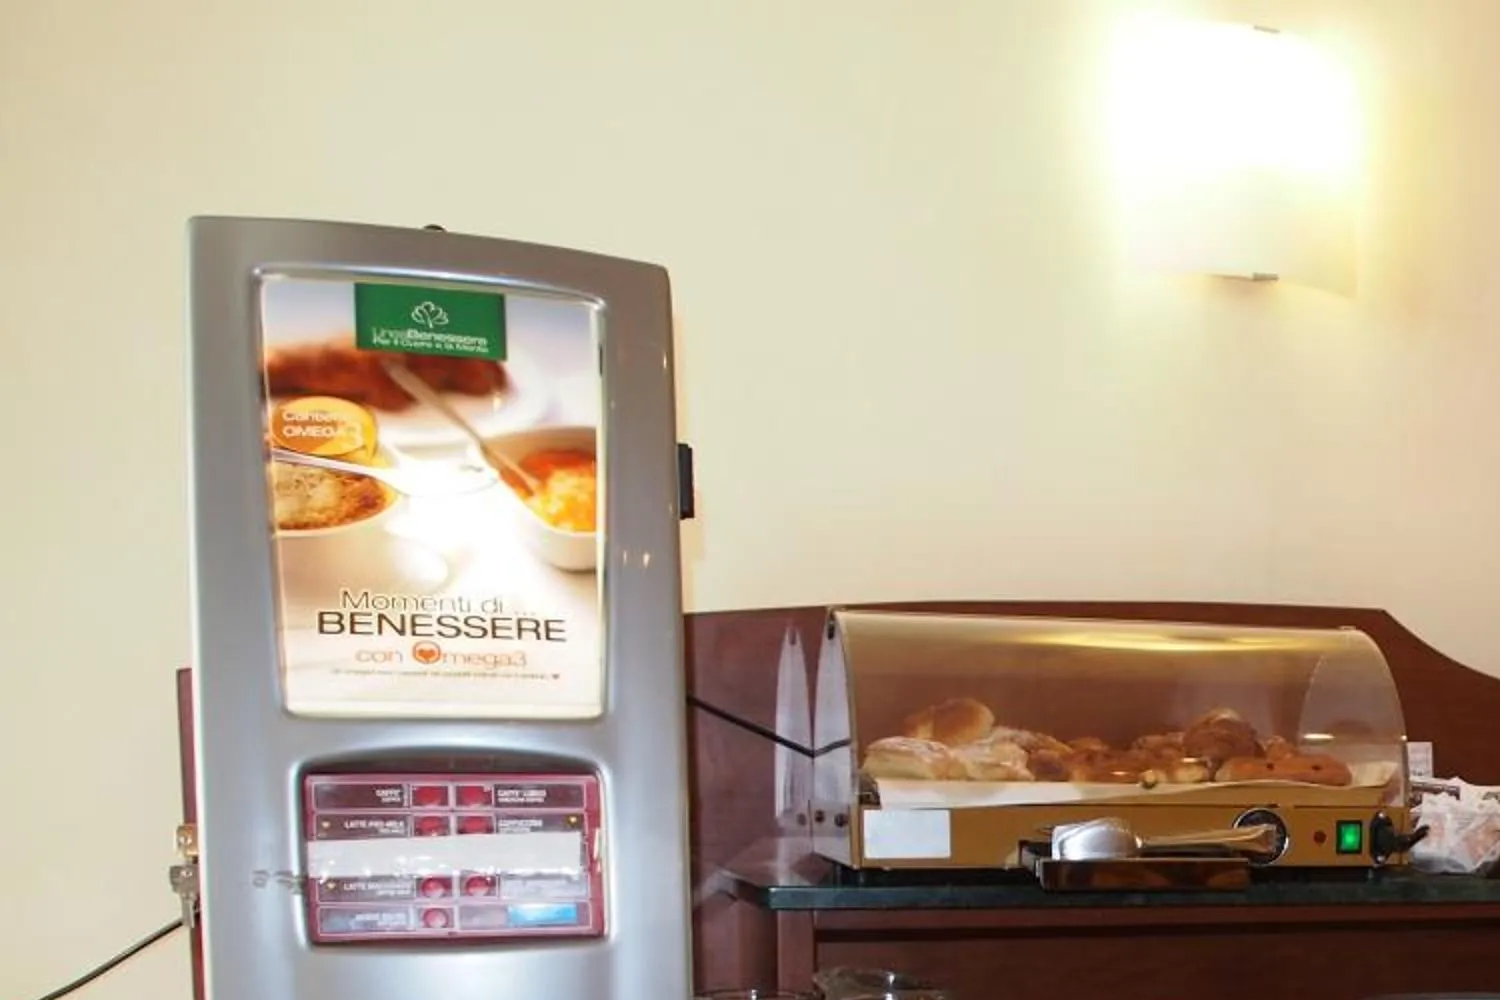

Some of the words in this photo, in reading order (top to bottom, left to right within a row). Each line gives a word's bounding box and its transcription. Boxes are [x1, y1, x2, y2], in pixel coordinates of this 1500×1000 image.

[341, 590, 472, 614] Momenti
[481, 596, 504, 614] di
[317, 611, 567, 643] BENESSERE
[355, 648, 404, 664] con
